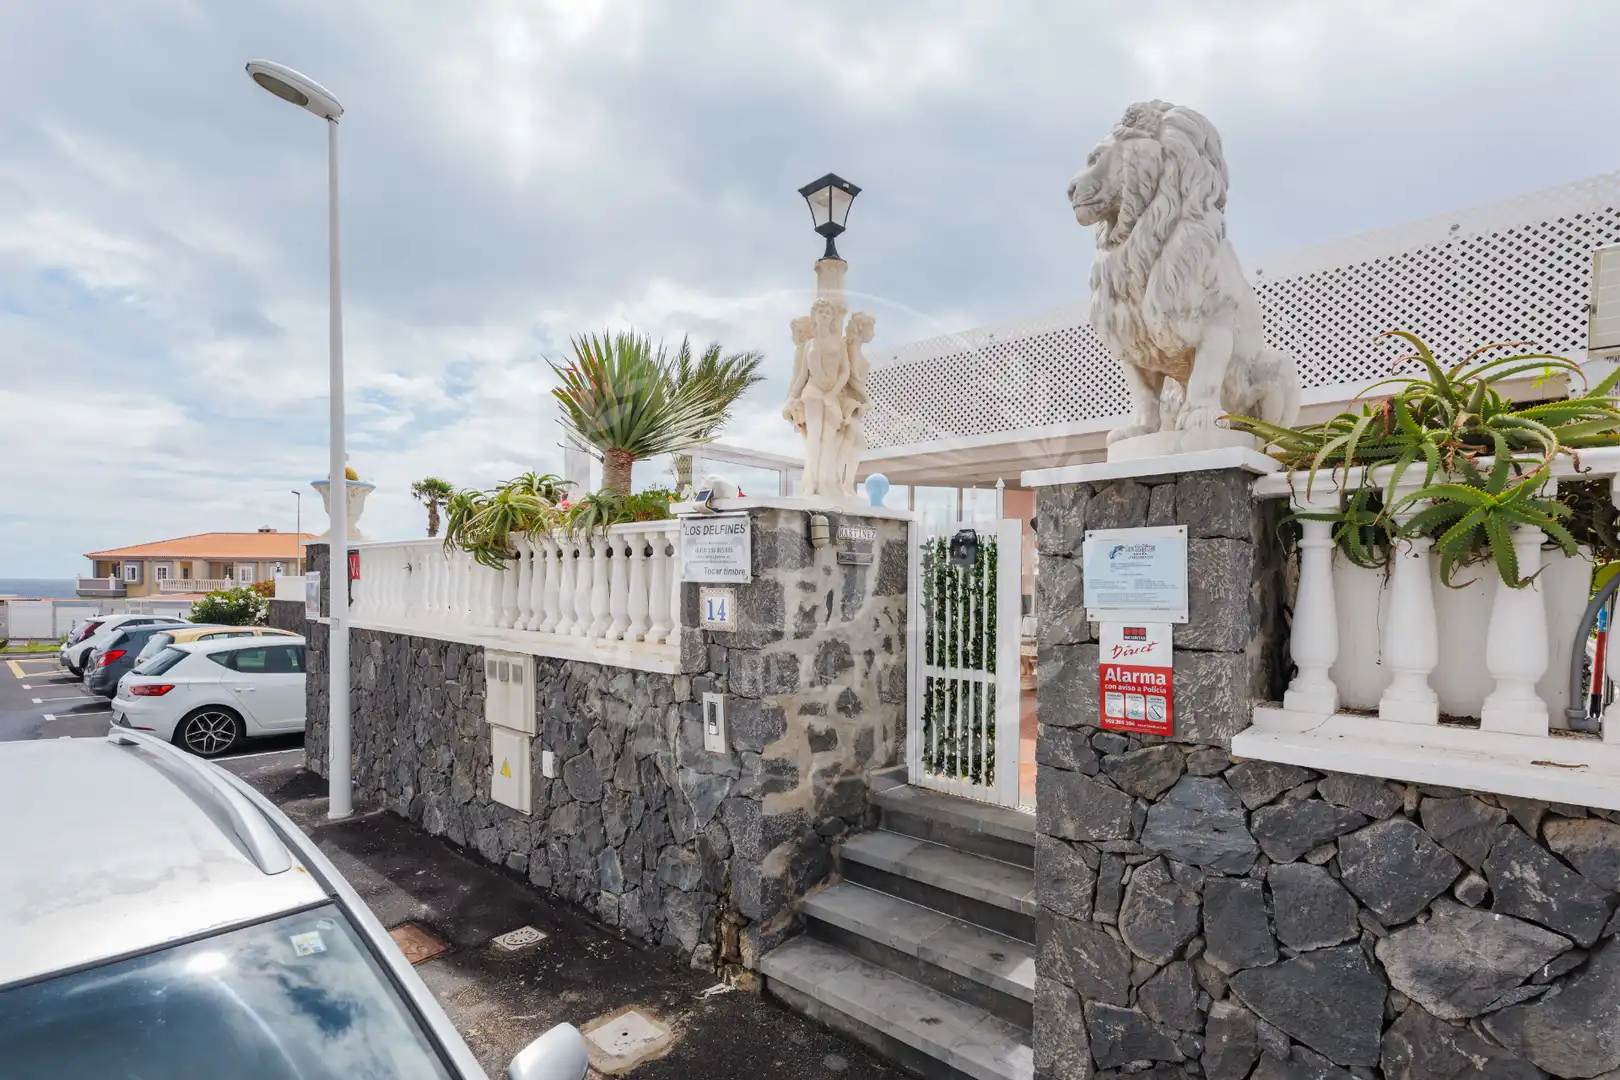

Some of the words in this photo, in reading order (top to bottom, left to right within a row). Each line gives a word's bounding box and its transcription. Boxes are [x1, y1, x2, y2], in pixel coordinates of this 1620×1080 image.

[684, 525, 701, 536] LOS
[702, 523, 746, 536] DELFINES
[703, 566, 723, 576] Tocar
[723, 566, 746, 576] timbre
[706, 598, 727, 622] 14
[1111, 641, 1161, 659] Direct
[1105, 667, 1167, 686] Alarma
[1117, 683, 1136, 692] aviso
